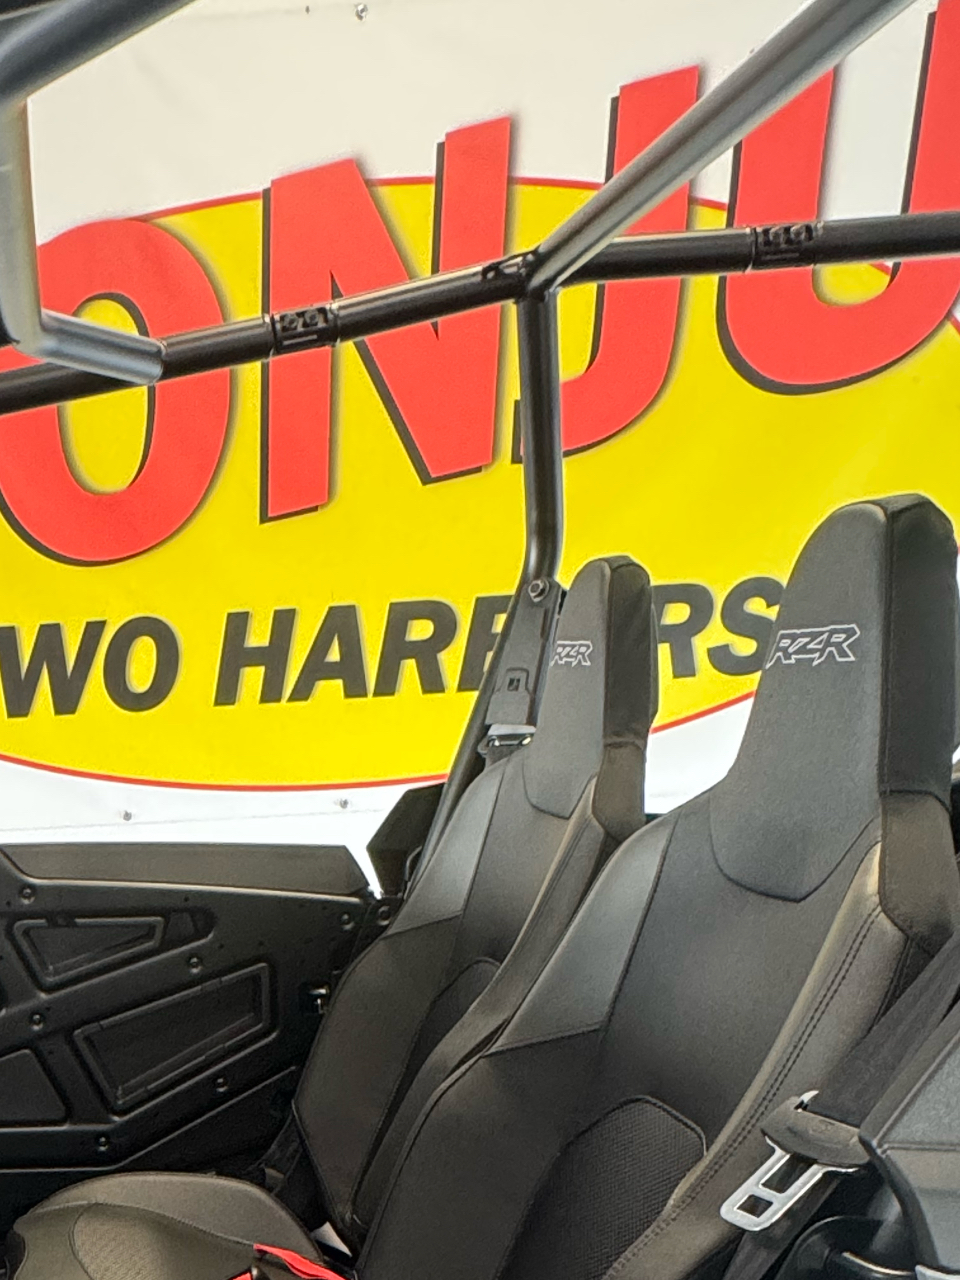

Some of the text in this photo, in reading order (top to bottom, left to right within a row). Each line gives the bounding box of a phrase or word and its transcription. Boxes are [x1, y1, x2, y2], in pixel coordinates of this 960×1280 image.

[214, 576, 785, 706] HARRS
[551, 640, 592, 667] RZR
[765, 624, 860, 669] RZR
